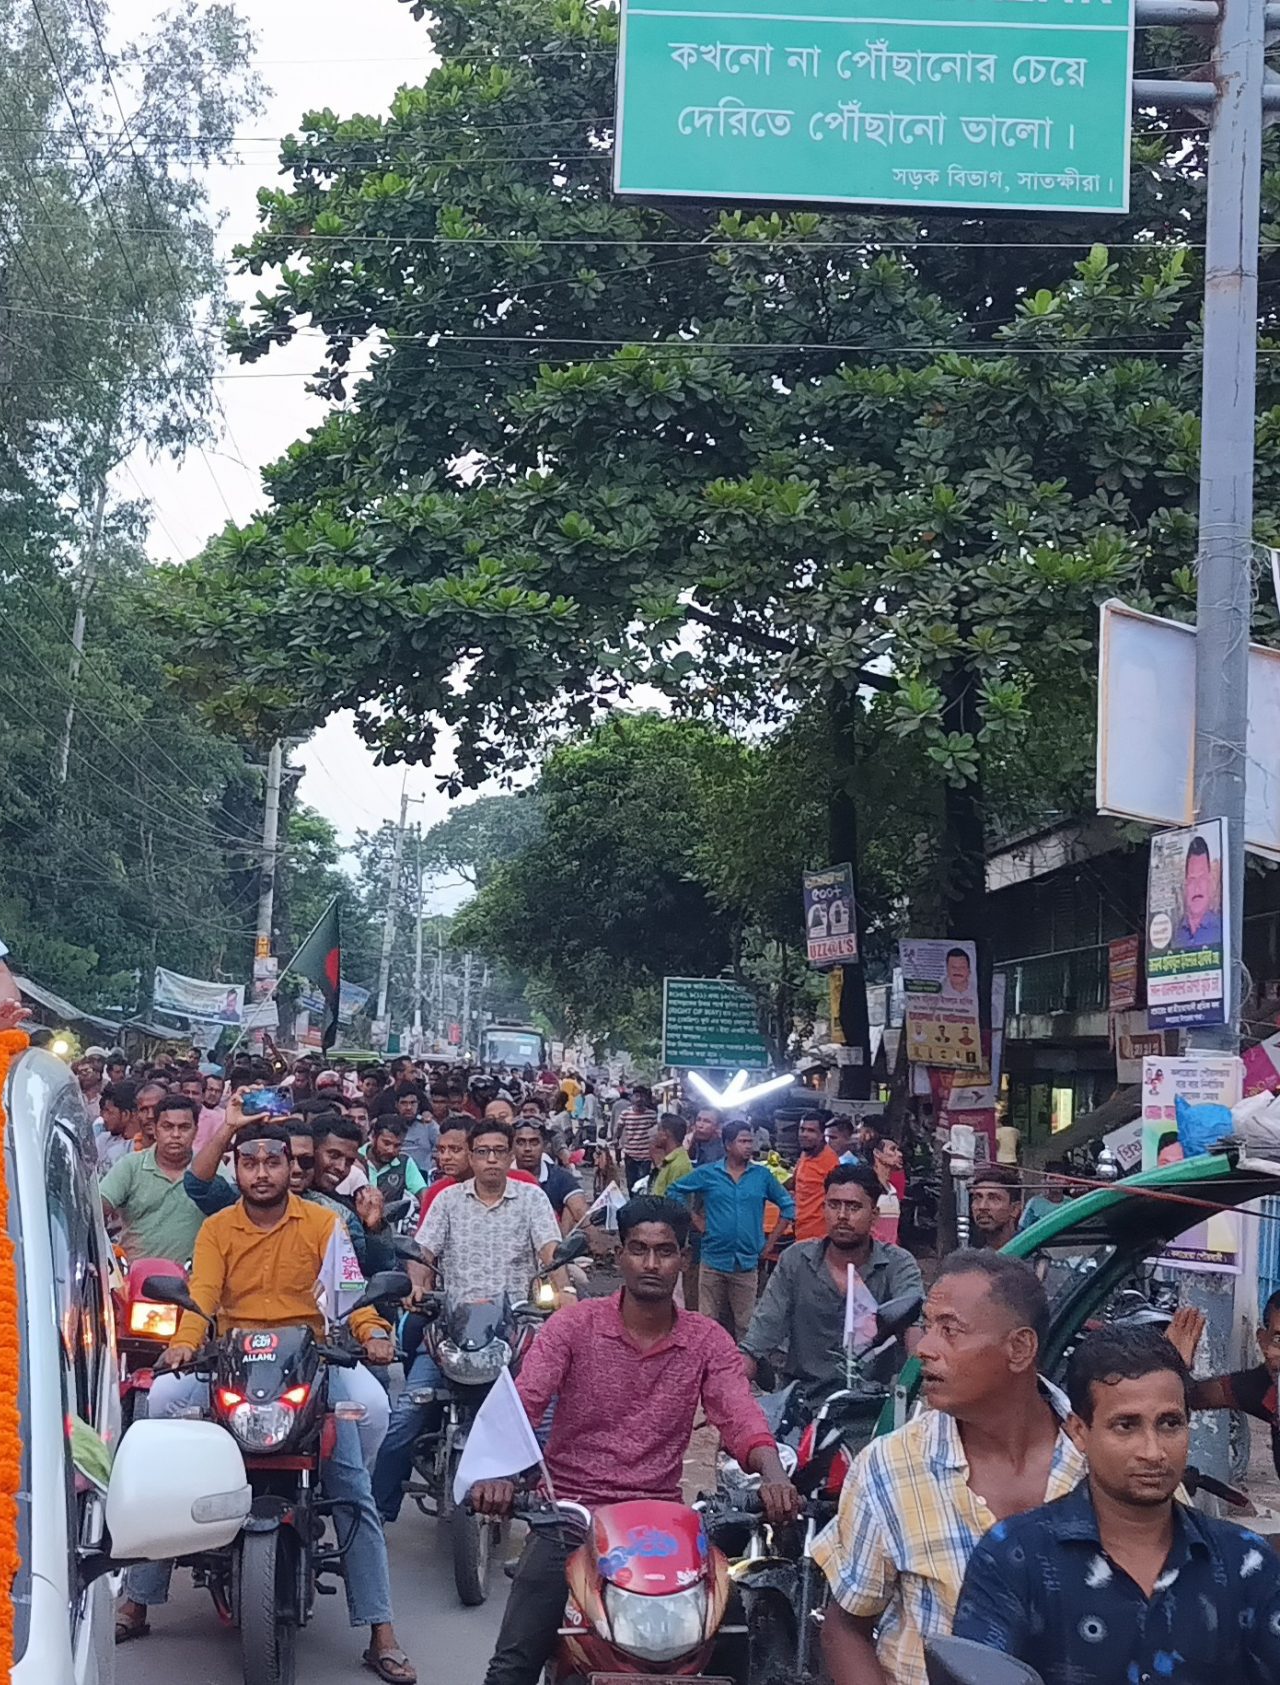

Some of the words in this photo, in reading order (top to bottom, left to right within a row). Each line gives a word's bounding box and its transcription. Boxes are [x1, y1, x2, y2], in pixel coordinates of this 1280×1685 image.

[669, 41, 774, 76] কখনো
[786, 46, 822, 78] না
[837, 38, 998, 83] পৌঁছানোর
[1013, 55, 1087, 88] চেয়ে
[677, 96, 795, 138] দেরিতে
[808, 101, 946, 145] পৌঁছানো
[961, 117, 1053, 150] ভালো
[892, 168, 940, 190] সড়ক
[947, 163, 1010, 192] বিভাগ,
[1017, 167, 1101, 193] সাতক্ষীরা
[242, 1353, 276, 1363] ALLAHU
